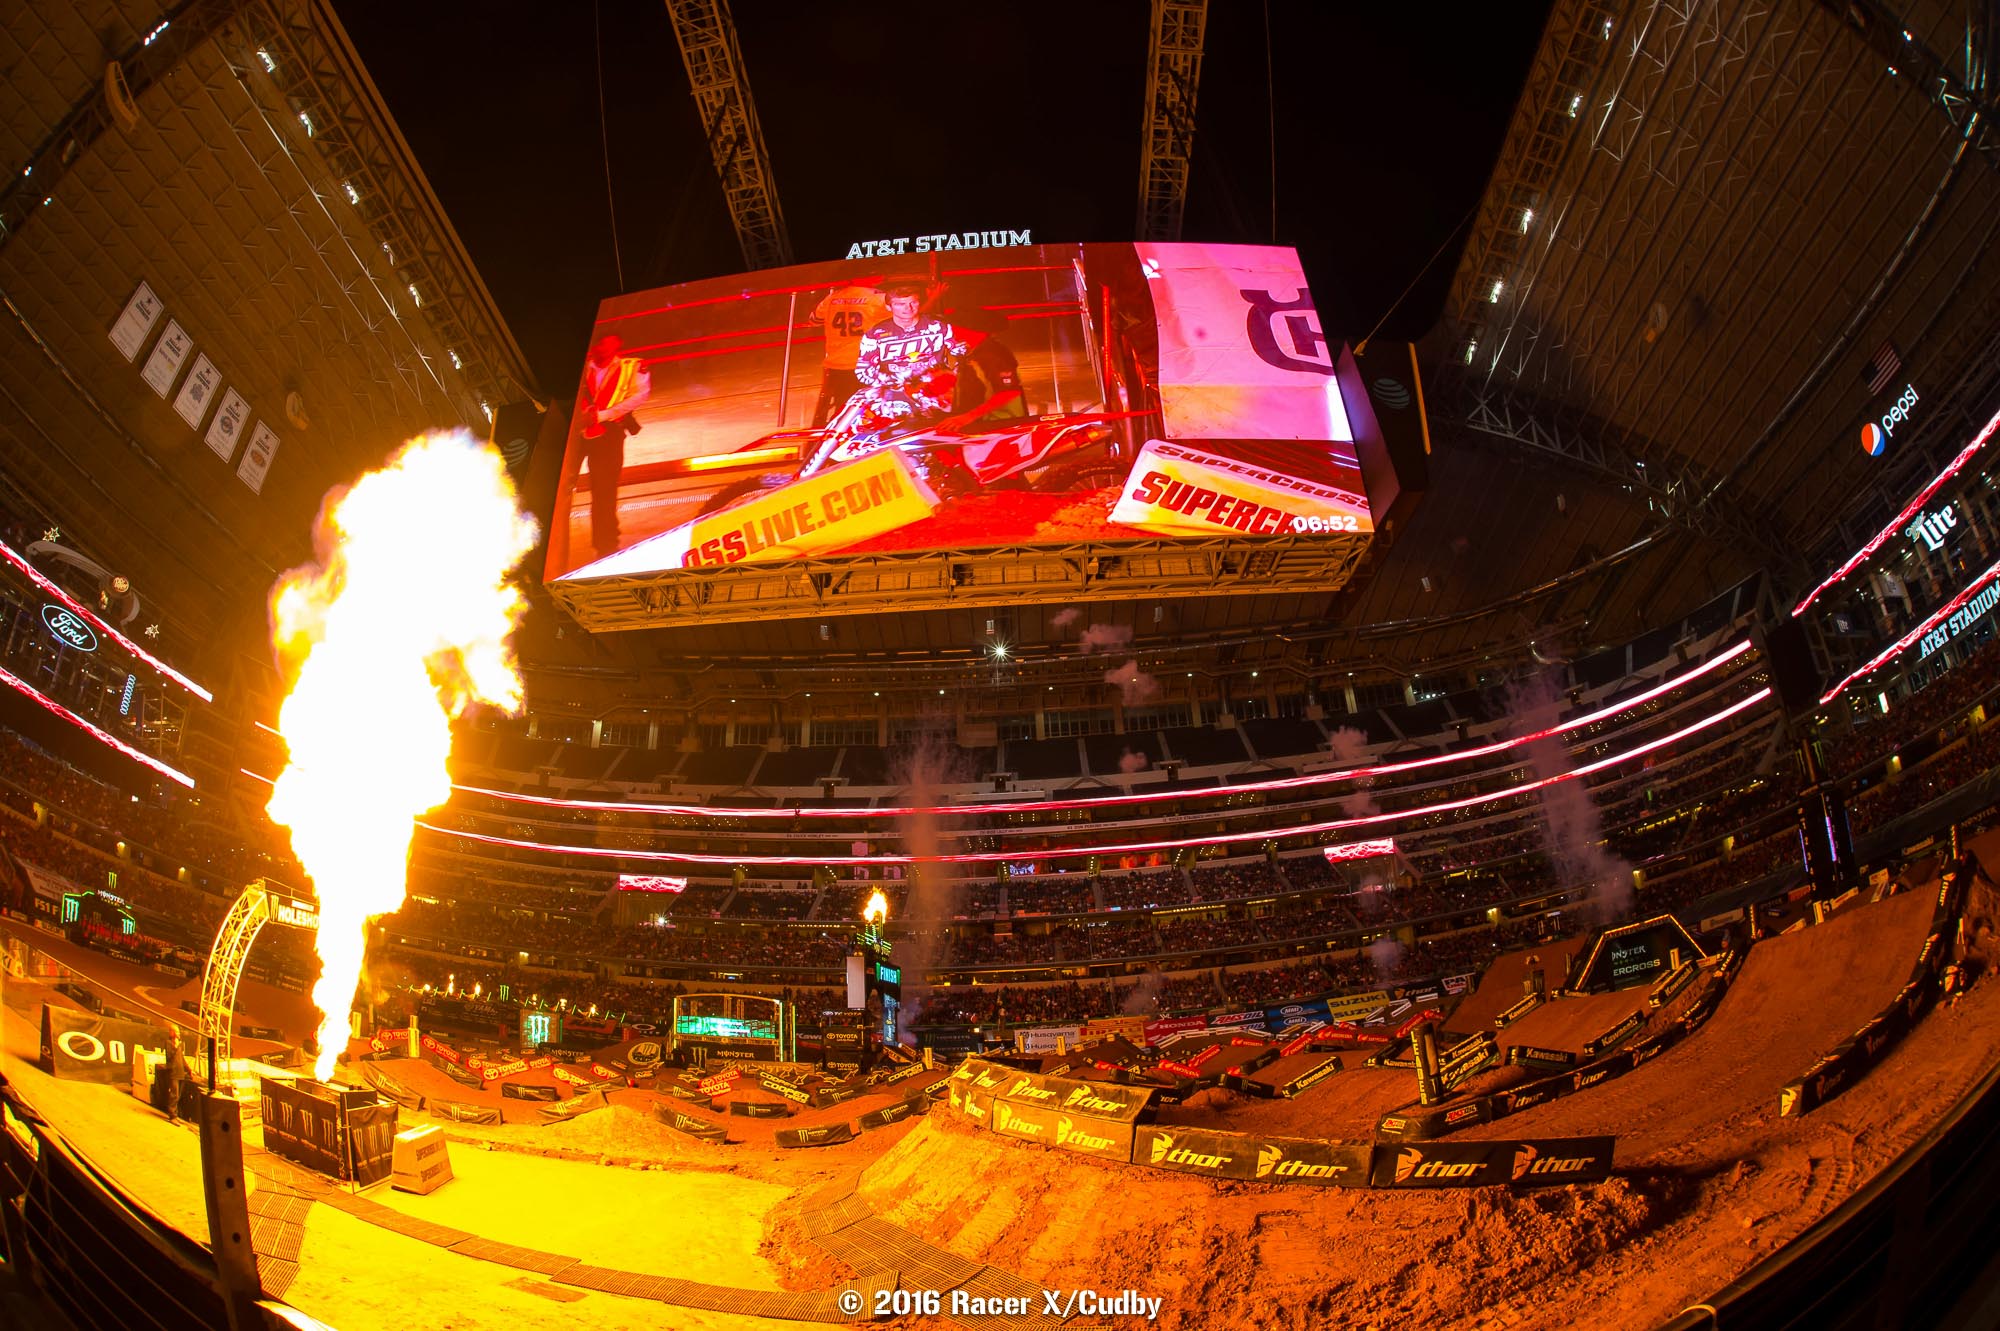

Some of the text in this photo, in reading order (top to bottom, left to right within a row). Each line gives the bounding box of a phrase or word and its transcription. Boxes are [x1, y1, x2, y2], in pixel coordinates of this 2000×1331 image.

[846, 229, 1032, 260] AT&T STADIUM
[832, 311, 864, 337] 42
[879, 333, 944, 362] FOX
[1882, 384, 1920, 437] pepsi
[1916, 505, 1957, 552] Lite
[1920, 579, 2000, 659] AT&T STADIUM
[51, 612, 88, 646] Ford
[880, 965, 898, 985] FINISH
[1613, 958, 1661, 977] ERCROSS
[1330, 994, 1386, 1008] SUZUKI
[1160, 1020, 1206, 1029] HONDA
[1211, 1010, 1265, 1025] AMSOIL
[1031, 1031, 1076, 1039] Husqvarna
[1601, 1016, 1639, 1048] Kawasaki
[436, 1043, 458, 1060] TOYOTA
[717, 1050, 755, 1059] MONSTER
[1452, 1036, 1484, 1059] Kawasaki
[1526, 1047, 1568, 1063] Kawasaki
[498, 1060, 526, 1073] TOYOTA
[529, 1057, 549, 1067] OYOTA
[1384, 1058, 1416, 1069] Kawasak
[1410, 1030, 1428, 1105] LEADER
[713, 1070, 739, 1083] TOYOTA
[1296, 1062, 1335, 1090] Kawasaki
[699, 1081, 731, 1094] TOYOTA
[763, 1080, 810, 1100] COOPER
[925, 1077, 952, 1094] COOP
[1078, 1096, 1128, 1112] thor
[1445, 1104, 1478, 1121] AMSOIL
[1008, 1118, 1043, 1135] thor
[1067, 1130, 1116, 1150] thor
[1167, 1149, 1233, 1169] thor
[1530, 1156, 1596, 1174] thor
[1274, 1159, 1349, 1179] thor
[1414, 1160, 1488, 1178] thor
